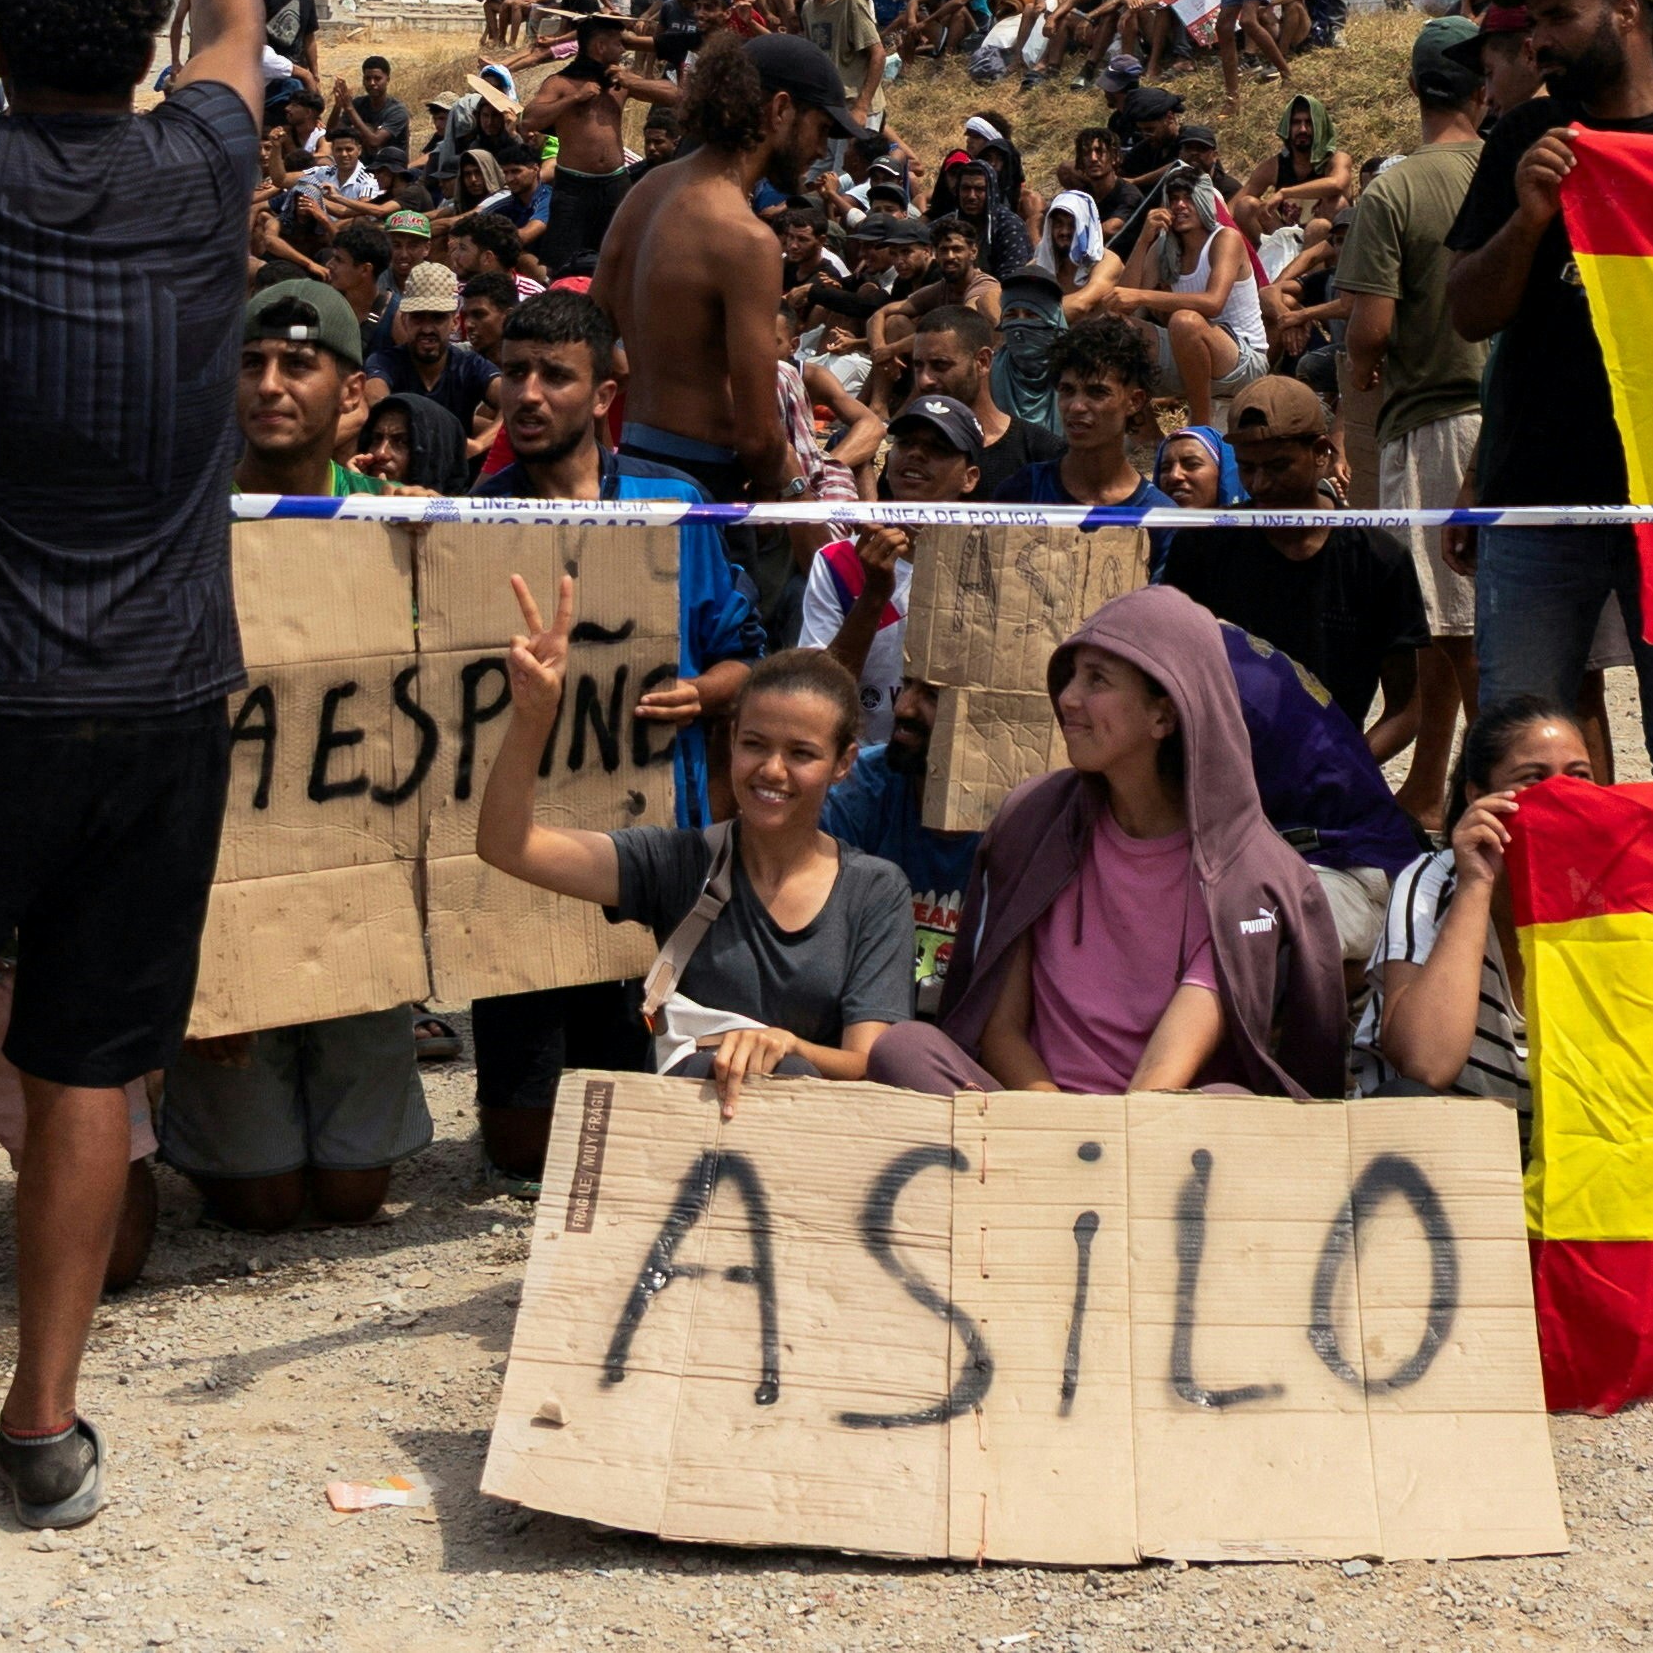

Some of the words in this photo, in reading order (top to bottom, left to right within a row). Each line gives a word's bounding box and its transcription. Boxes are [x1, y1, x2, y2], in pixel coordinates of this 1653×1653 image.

[869, 507, 930, 524] LINEA
[934, 509, 962, 525] DE
[967, 510, 1049, 526] POLICIA
[1239, 917, 1273, 935] PUMA
[586, 1088, 606, 1132] FRÁGIL
[582, 1135, 597, 1167] MUY
[572, 1177, 593, 1228] FRAGILE
